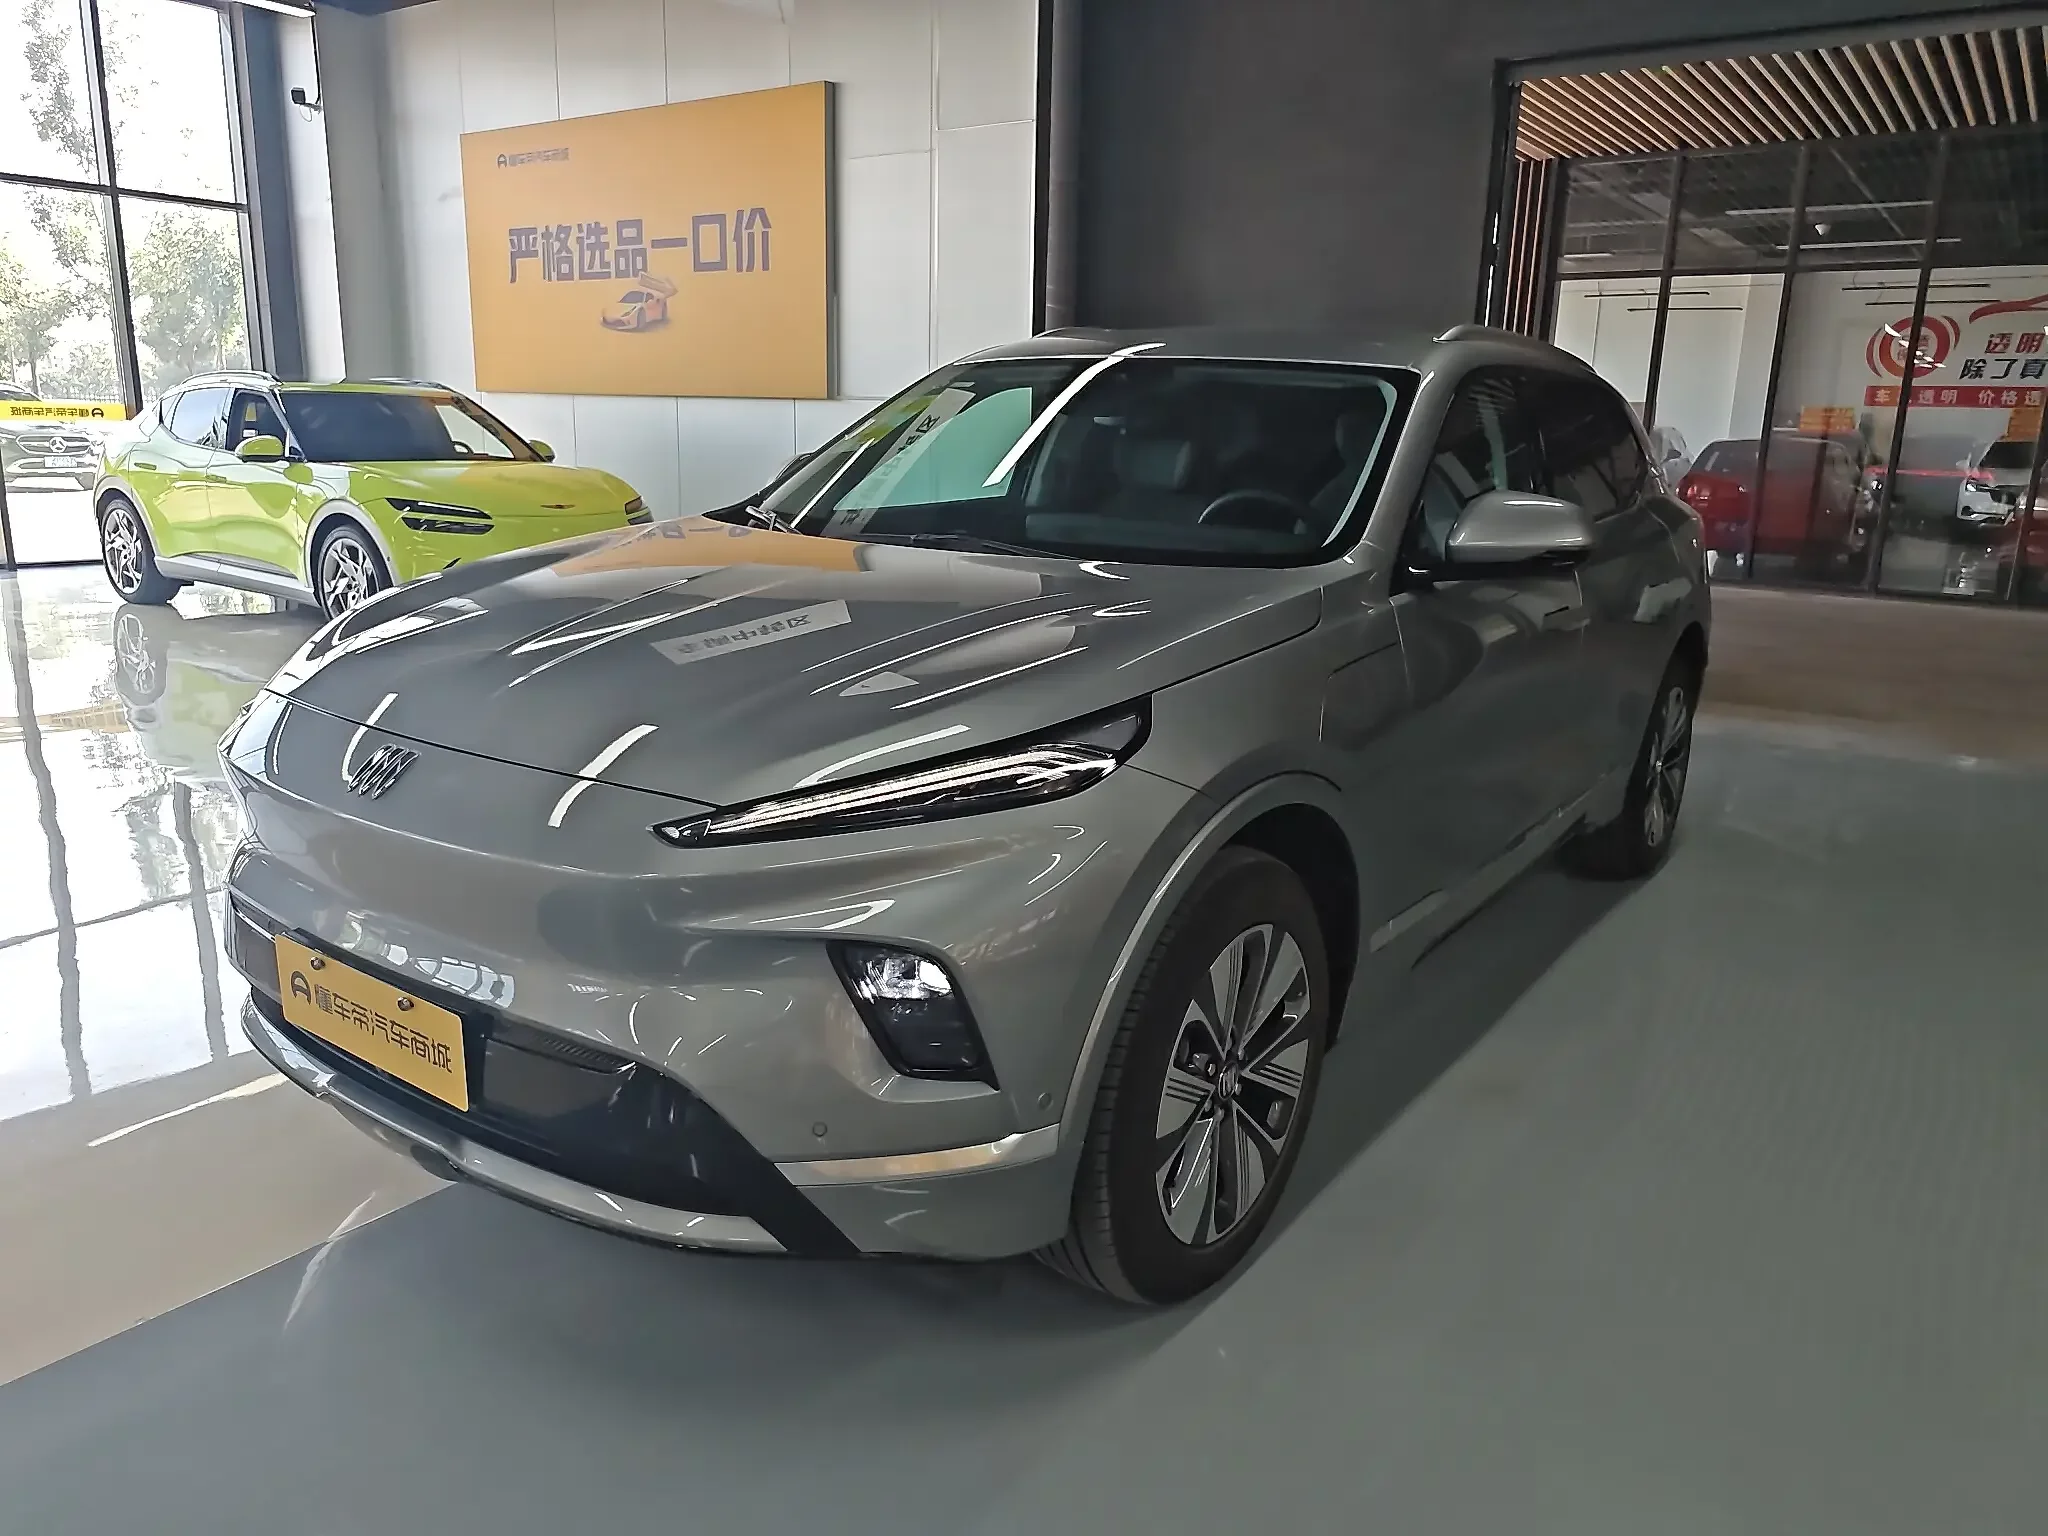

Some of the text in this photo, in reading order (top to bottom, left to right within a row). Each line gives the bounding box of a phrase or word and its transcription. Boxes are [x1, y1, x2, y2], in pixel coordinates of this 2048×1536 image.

[508, 207, 773, 284] 严格选品一口价
[1875, 389, 1958, 405] 车透明
